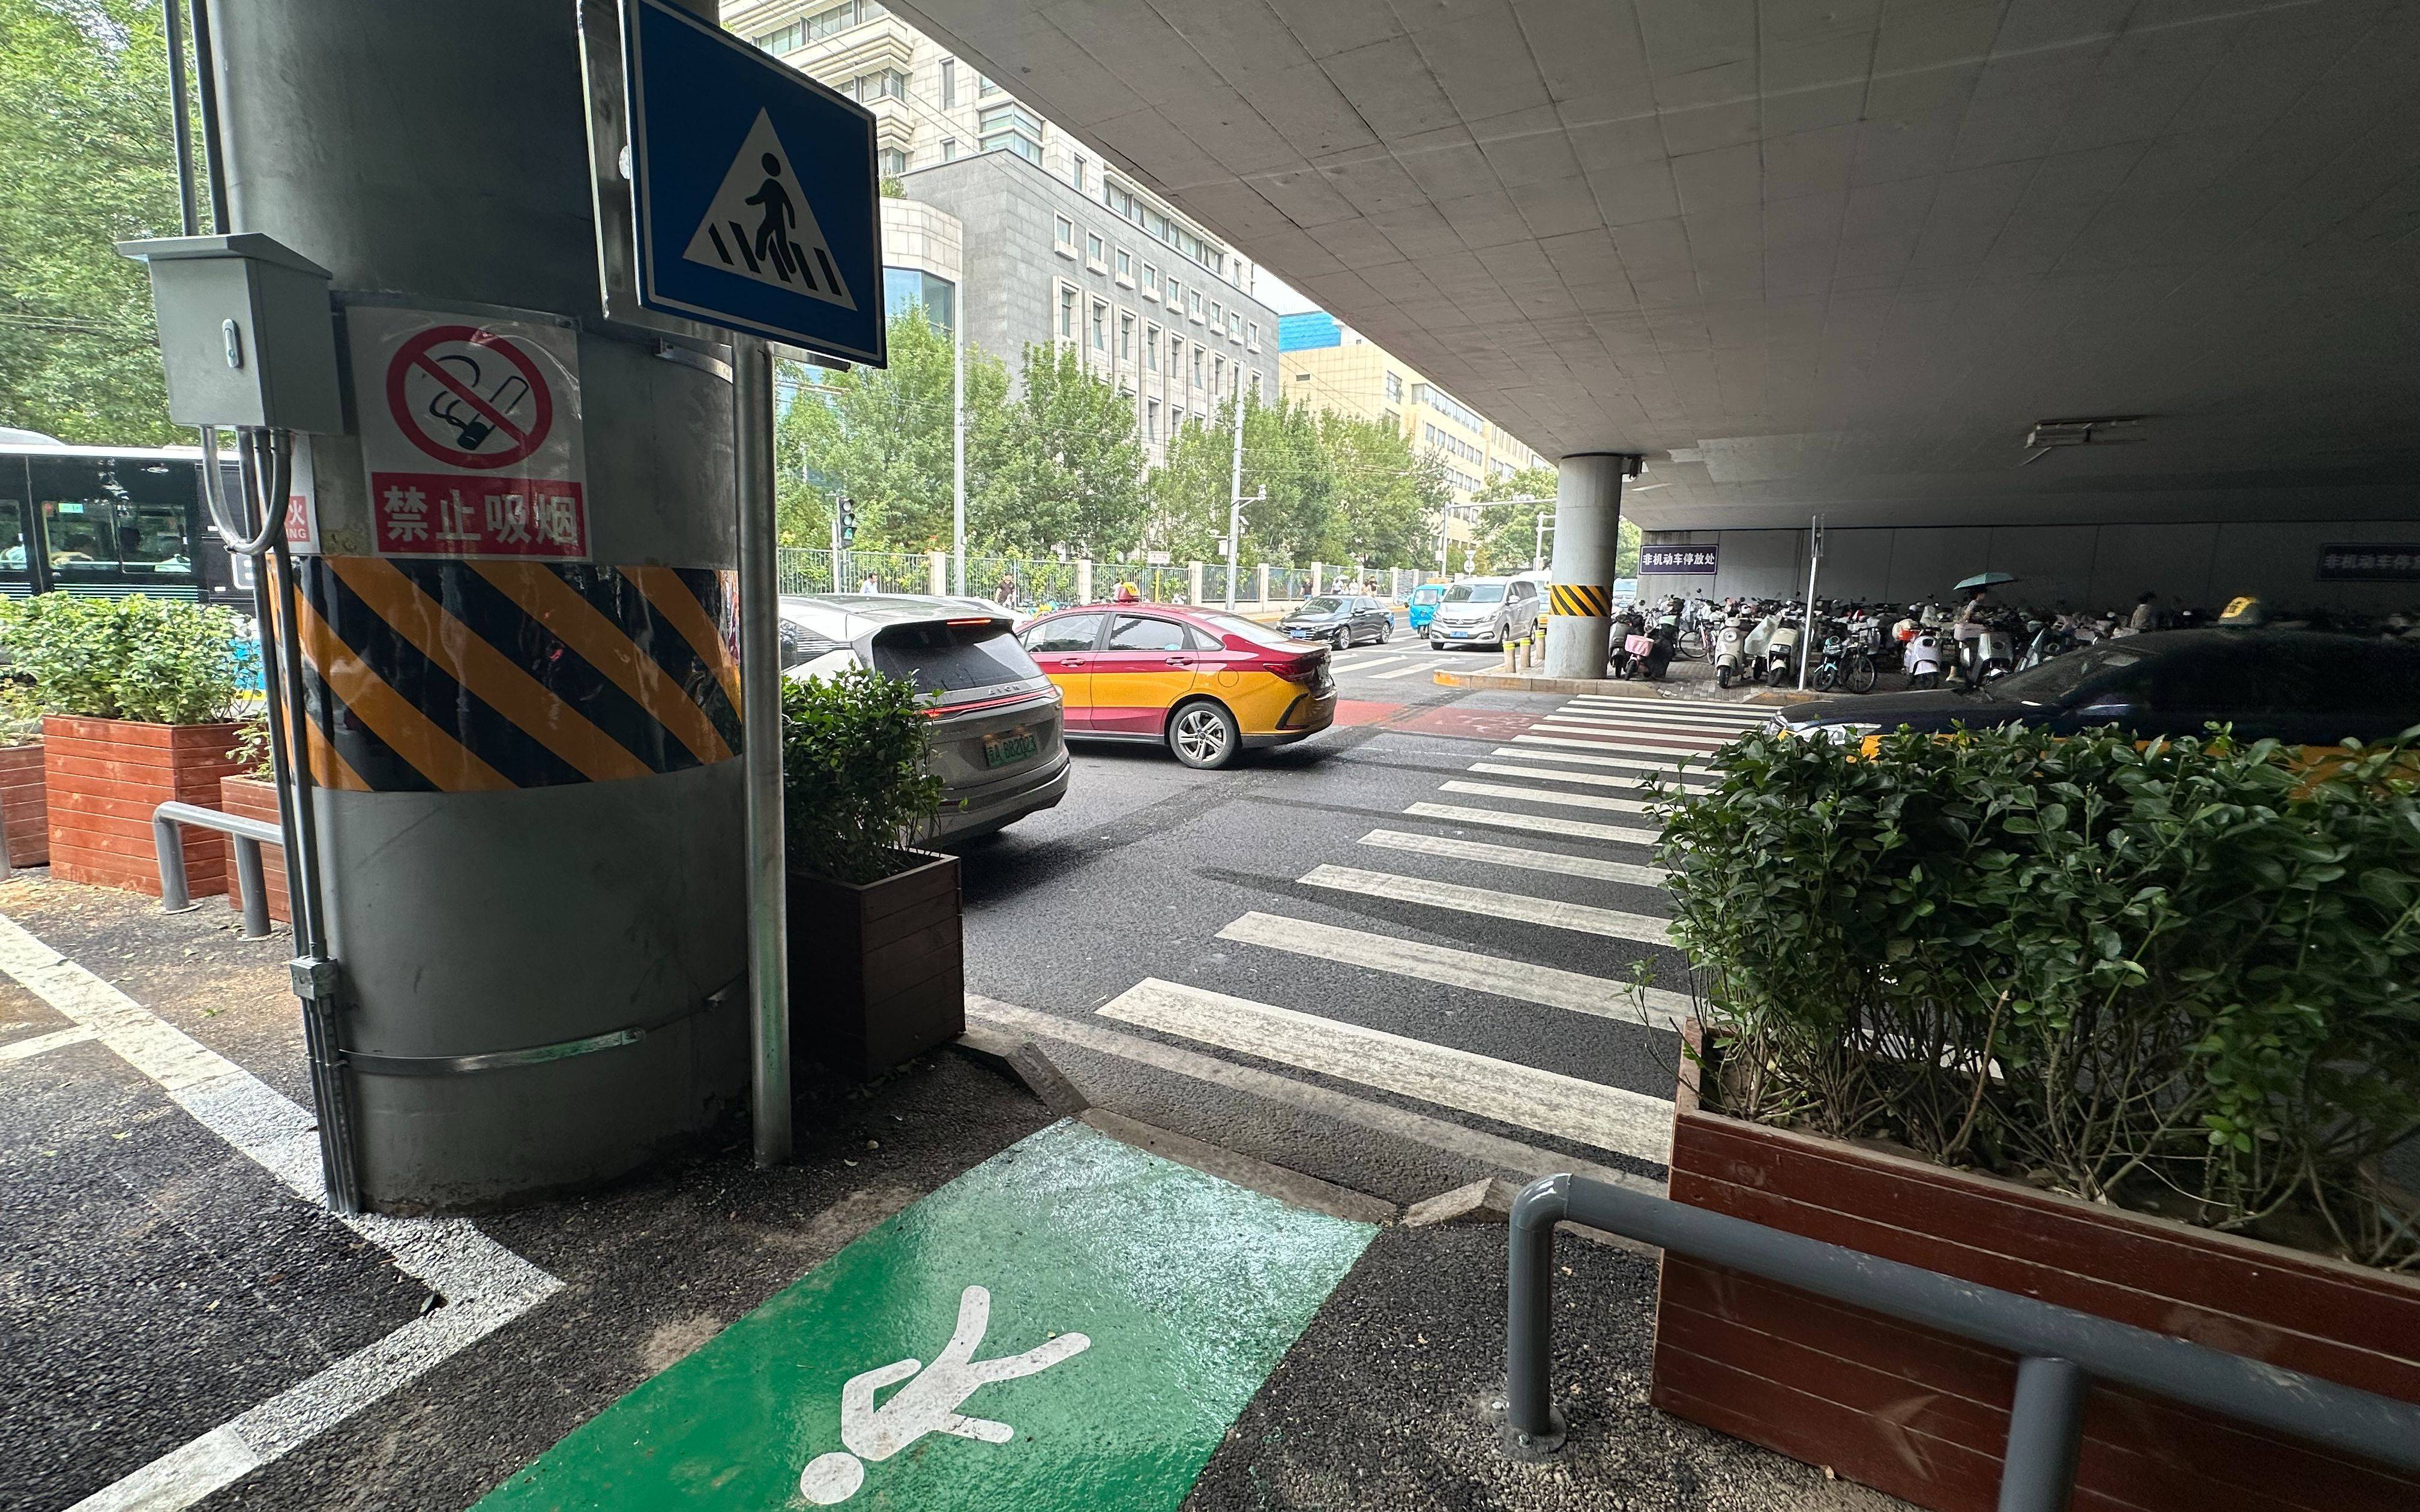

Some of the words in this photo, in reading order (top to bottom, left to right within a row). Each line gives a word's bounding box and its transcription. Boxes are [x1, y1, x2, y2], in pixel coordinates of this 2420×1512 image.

[289, 499, 305, 526] 火
[384, 485, 579, 546] 禁止吸烟
[286, 528, 307, 539] ING
[1642, 553, 1715, 565] 非机动车停放处
